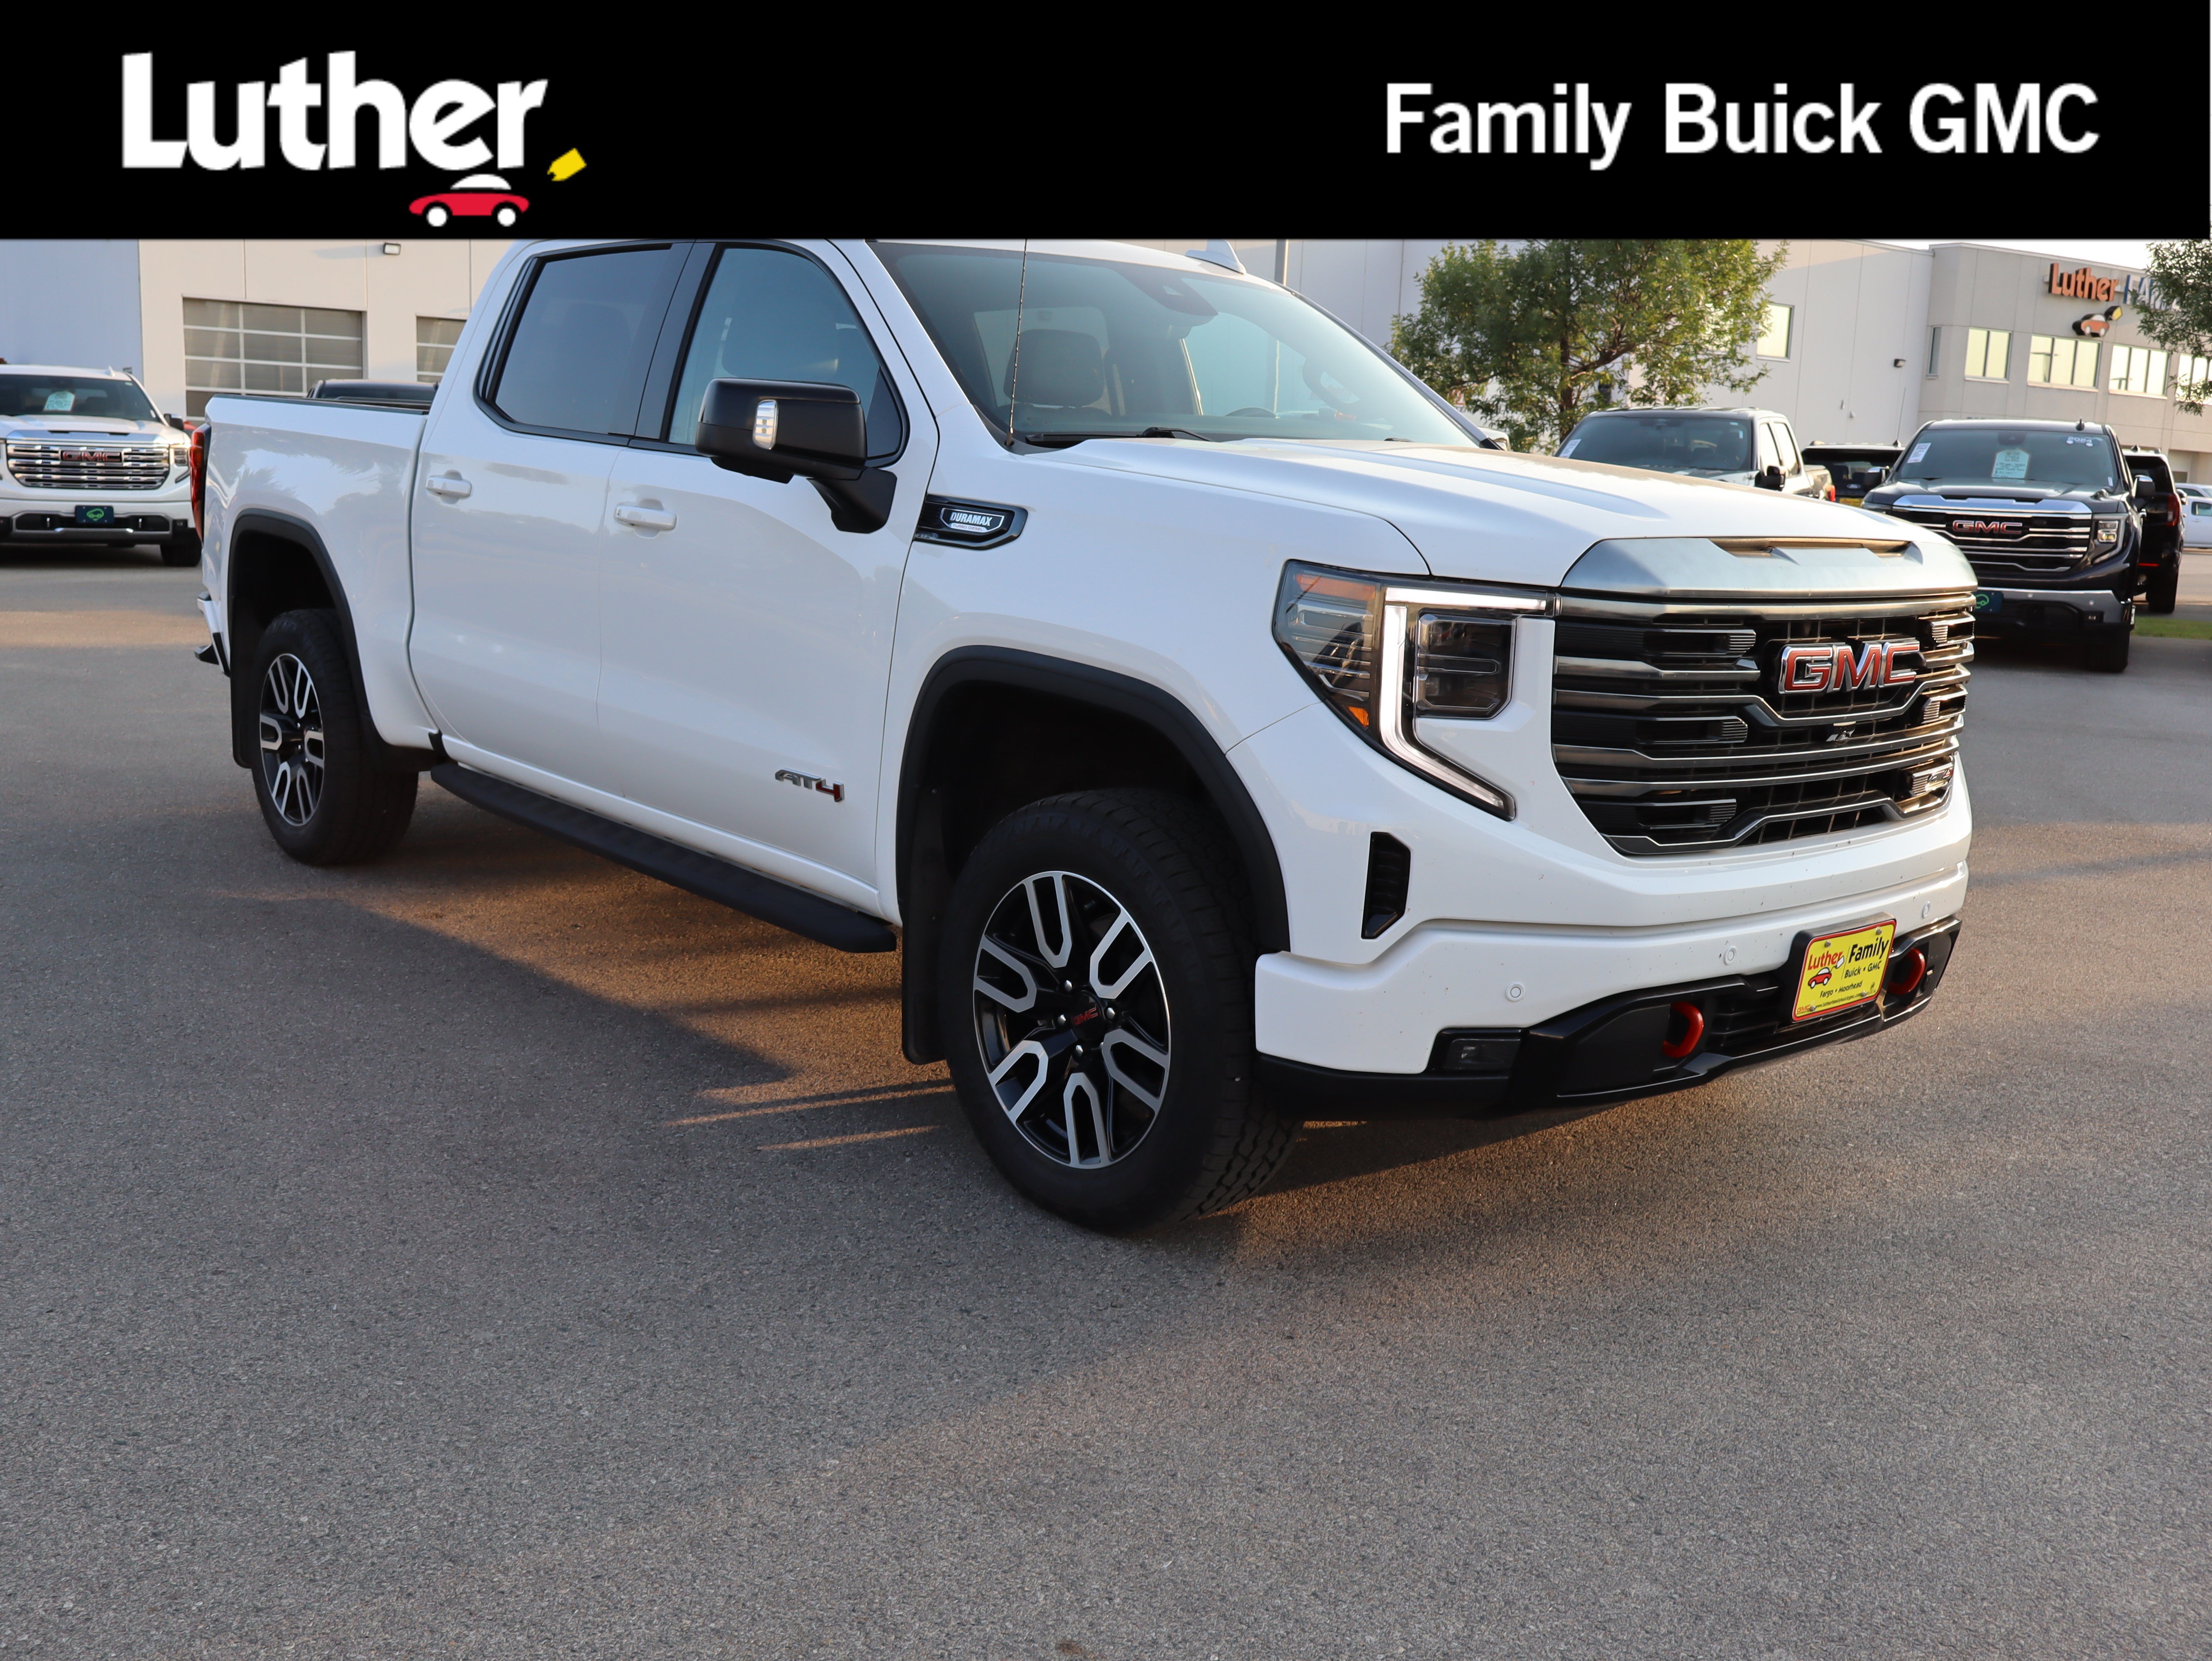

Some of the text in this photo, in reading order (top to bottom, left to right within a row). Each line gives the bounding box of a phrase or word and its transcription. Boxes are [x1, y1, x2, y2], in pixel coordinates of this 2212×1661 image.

[2048, 262, 2119, 301] Luther
[62, 451, 120, 461] GMC
[949, 512, 993, 527] DURAMAX
[1953, 520, 2023, 534] GMC
[1778, 641, 1920, 694] GMC
[775, 767, 845, 802] AT4
[1848, 936, 1889, 963] Family
[1808, 951, 1843, 970] Luther
[1844, 960, 1882, 979] Buick GMC
[1820, 990, 1833, 998] Fargo
[1838, 980, 1863, 993] Moorhead
[1073, 1007, 1098, 1025] GMC
